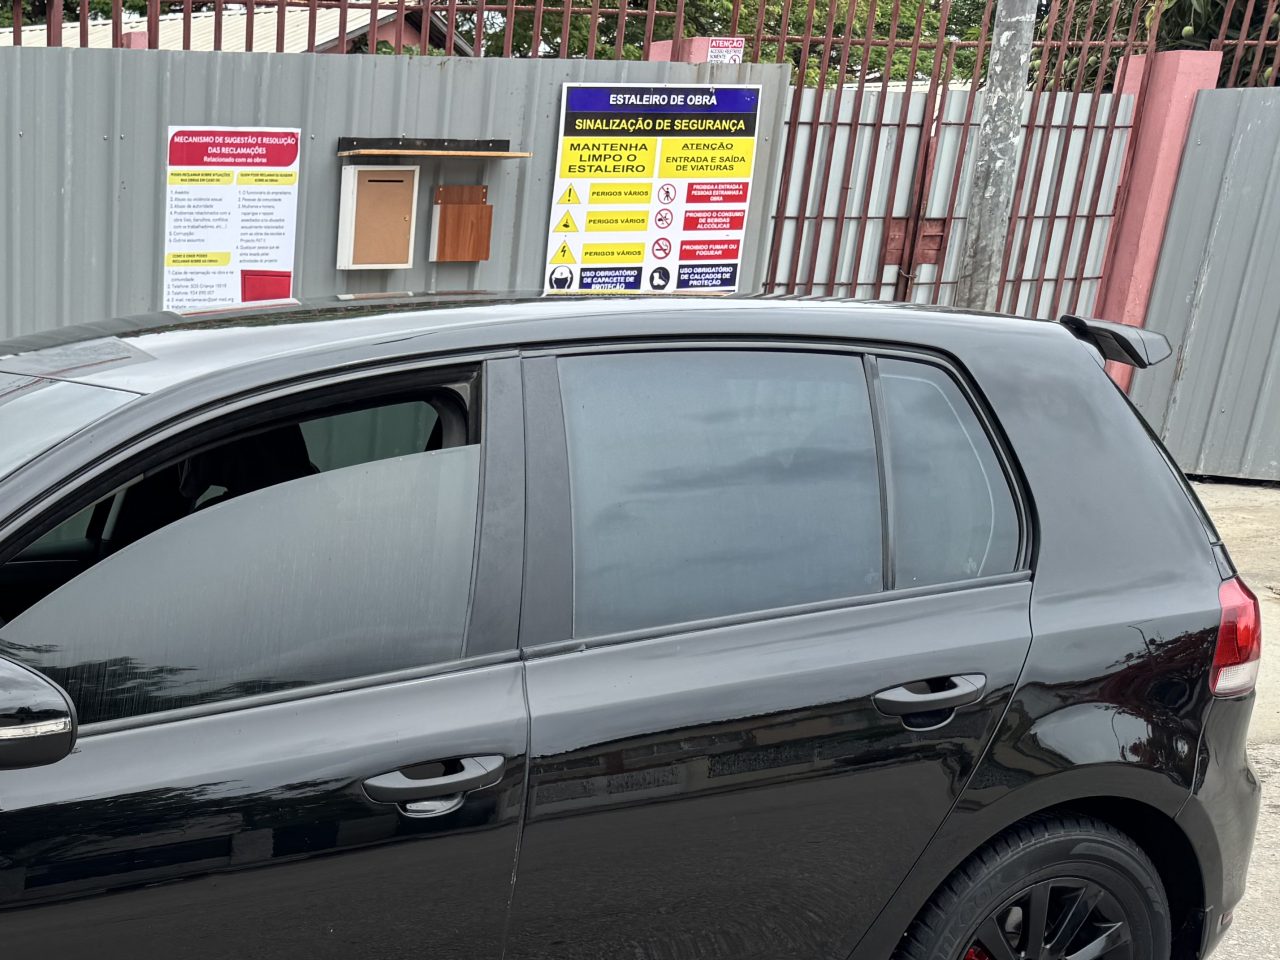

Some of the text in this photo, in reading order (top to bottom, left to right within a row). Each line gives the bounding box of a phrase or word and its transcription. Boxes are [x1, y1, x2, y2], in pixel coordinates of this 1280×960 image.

[610, 95, 717, 105] ESTALEIRO DE OBRA
[575, 118, 745, 132] SINALIZAÇÃO DE SEGURANÇA
[225, 135, 256, 143] SUGESTÃO
[263, 136, 296, 145] RESOLUÇÃO
[569, 143, 648, 151] MANTENHA
[681, 142, 734, 150] ATENÇÃO
[221, 146, 266, 155] RECLAMAÇÕES
[579, 154, 637, 162] LIMPO O
[719, 155, 746, 163] SAÍDA
[568, 165, 646, 173] ESTALEIRO
